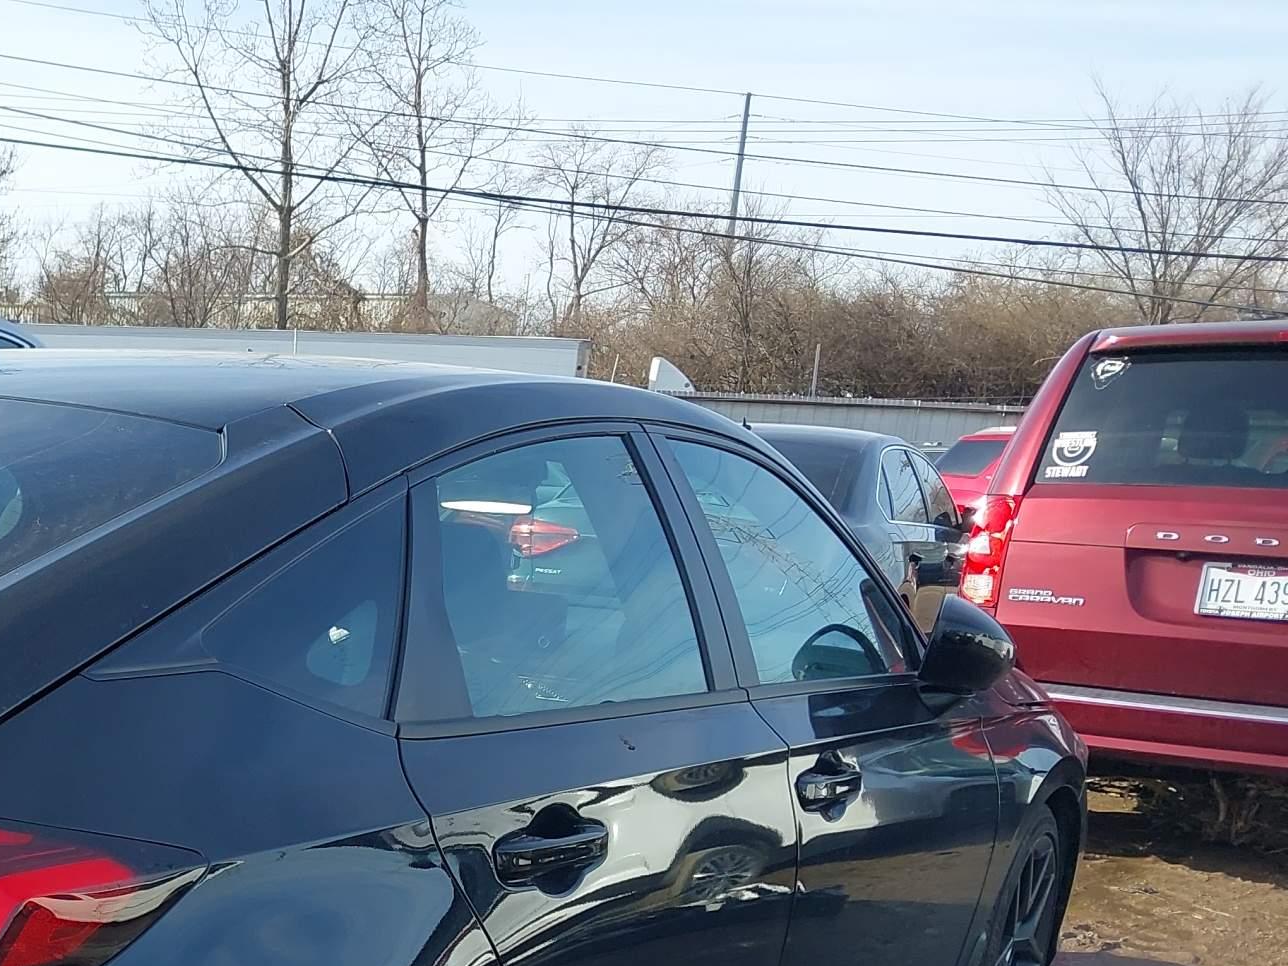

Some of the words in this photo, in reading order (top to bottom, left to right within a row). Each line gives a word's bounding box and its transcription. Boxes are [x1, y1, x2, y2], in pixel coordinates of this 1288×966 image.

[1045, 466, 1089, 477] STEWART
[1247, 569, 1276, 577] OHIO
[1009, 588, 1052, 596] GRAND
[1207, 578, 1245, 604] HZL
[1008, 594, 1085, 606] CARAVAN
